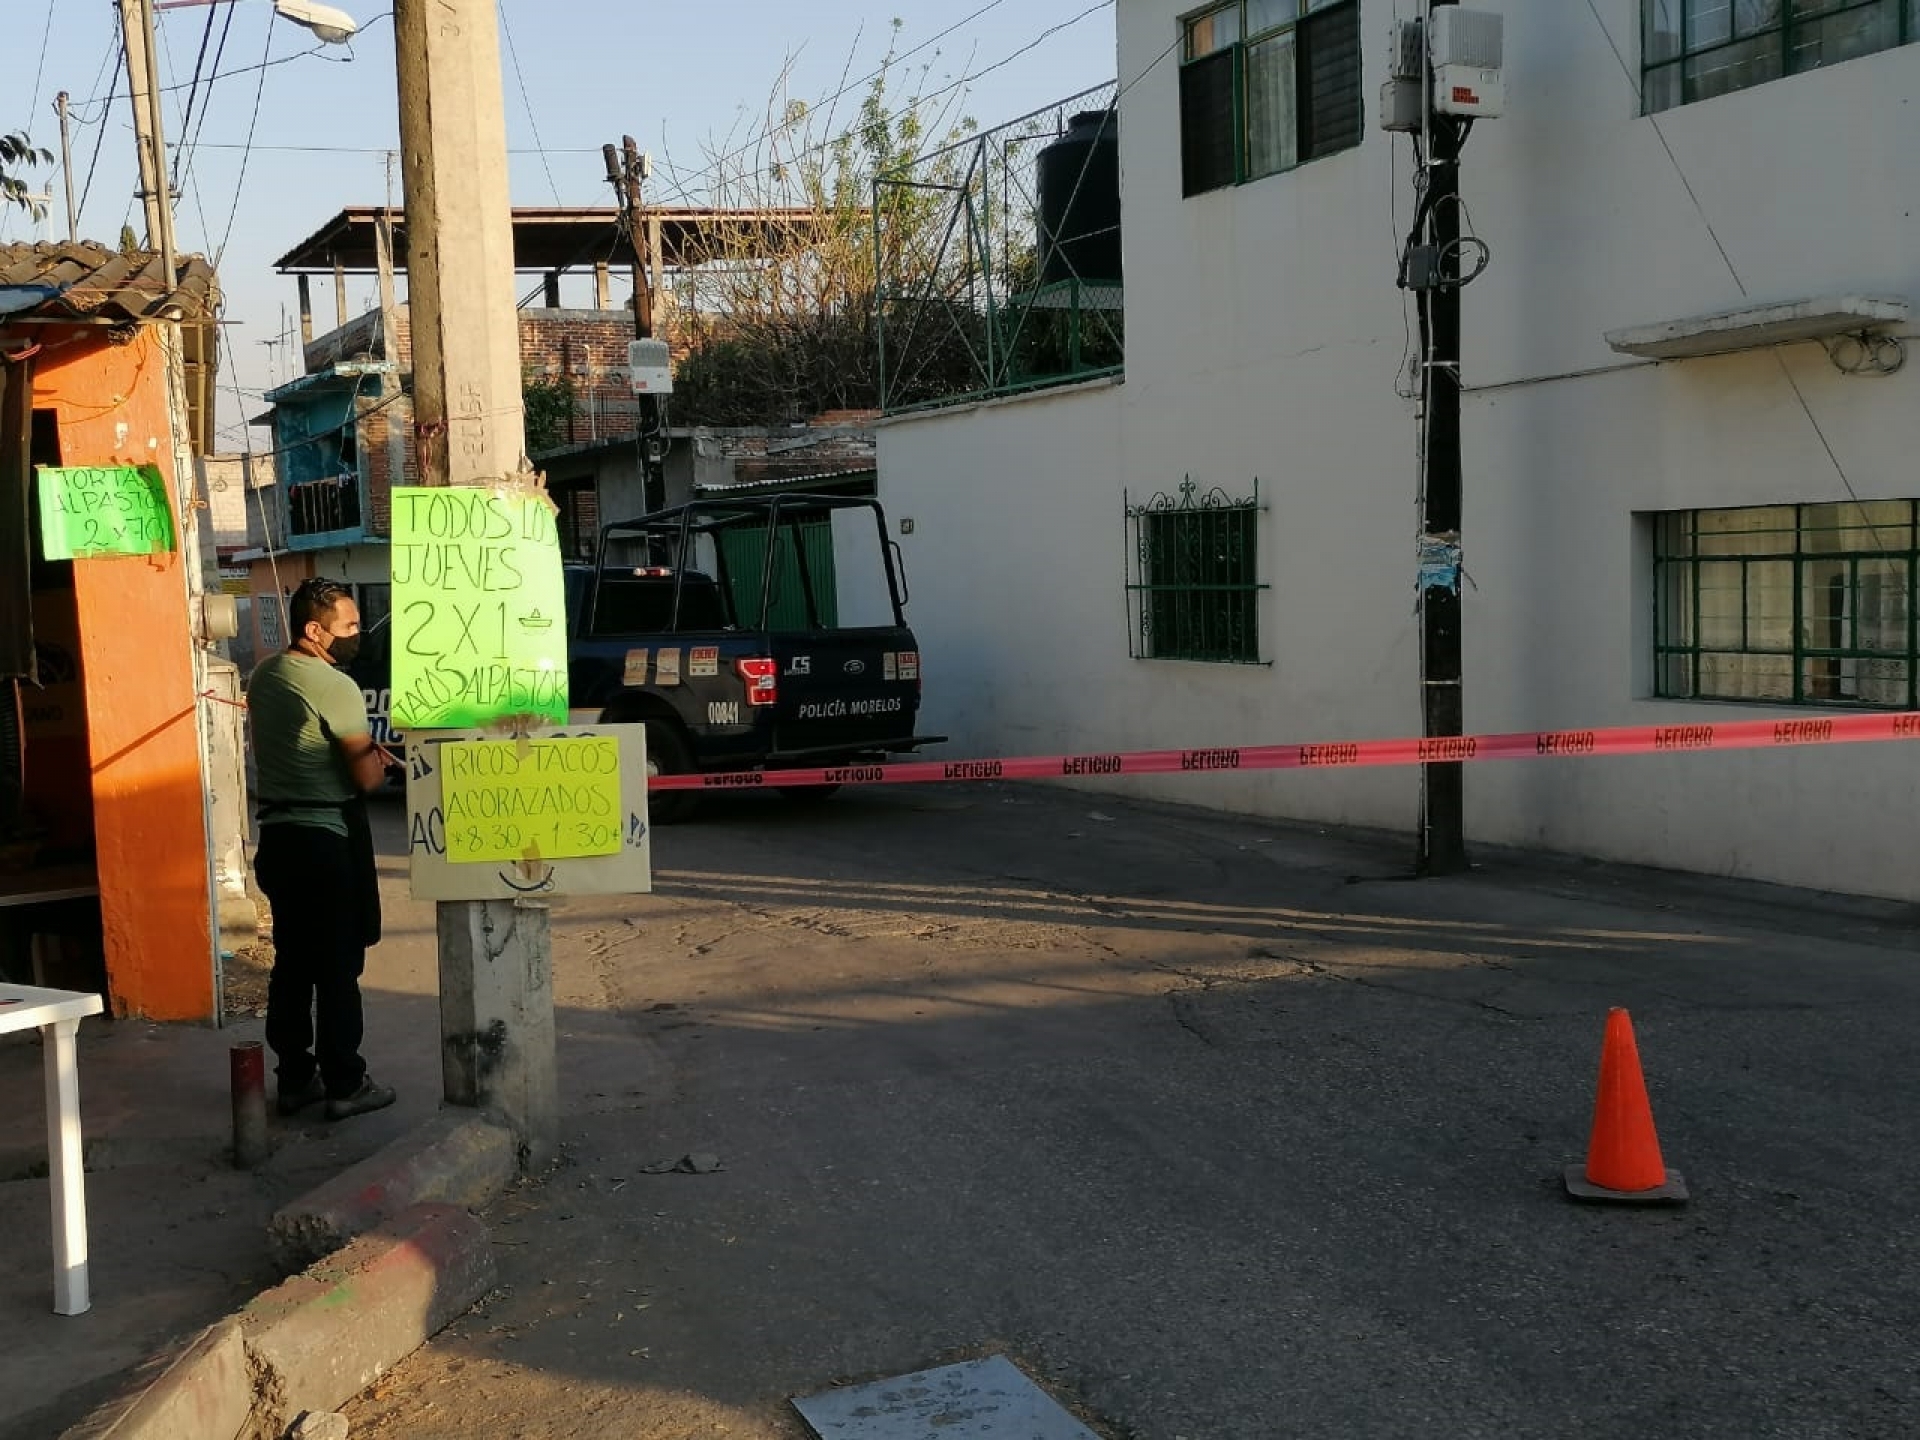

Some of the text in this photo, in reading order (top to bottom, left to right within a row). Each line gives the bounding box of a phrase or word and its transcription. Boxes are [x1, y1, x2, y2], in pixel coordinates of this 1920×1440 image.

[396, 493, 513, 539] TODOS
[393, 543, 523, 591] JUEVES
[391, 654, 468, 724] TACOS
[798, 697, 901, 719] POLICÍA MORELOS
[451, 742, 617, 780] RICOS TACOS
[447, 784, 611, 822] ACORAZADOS
